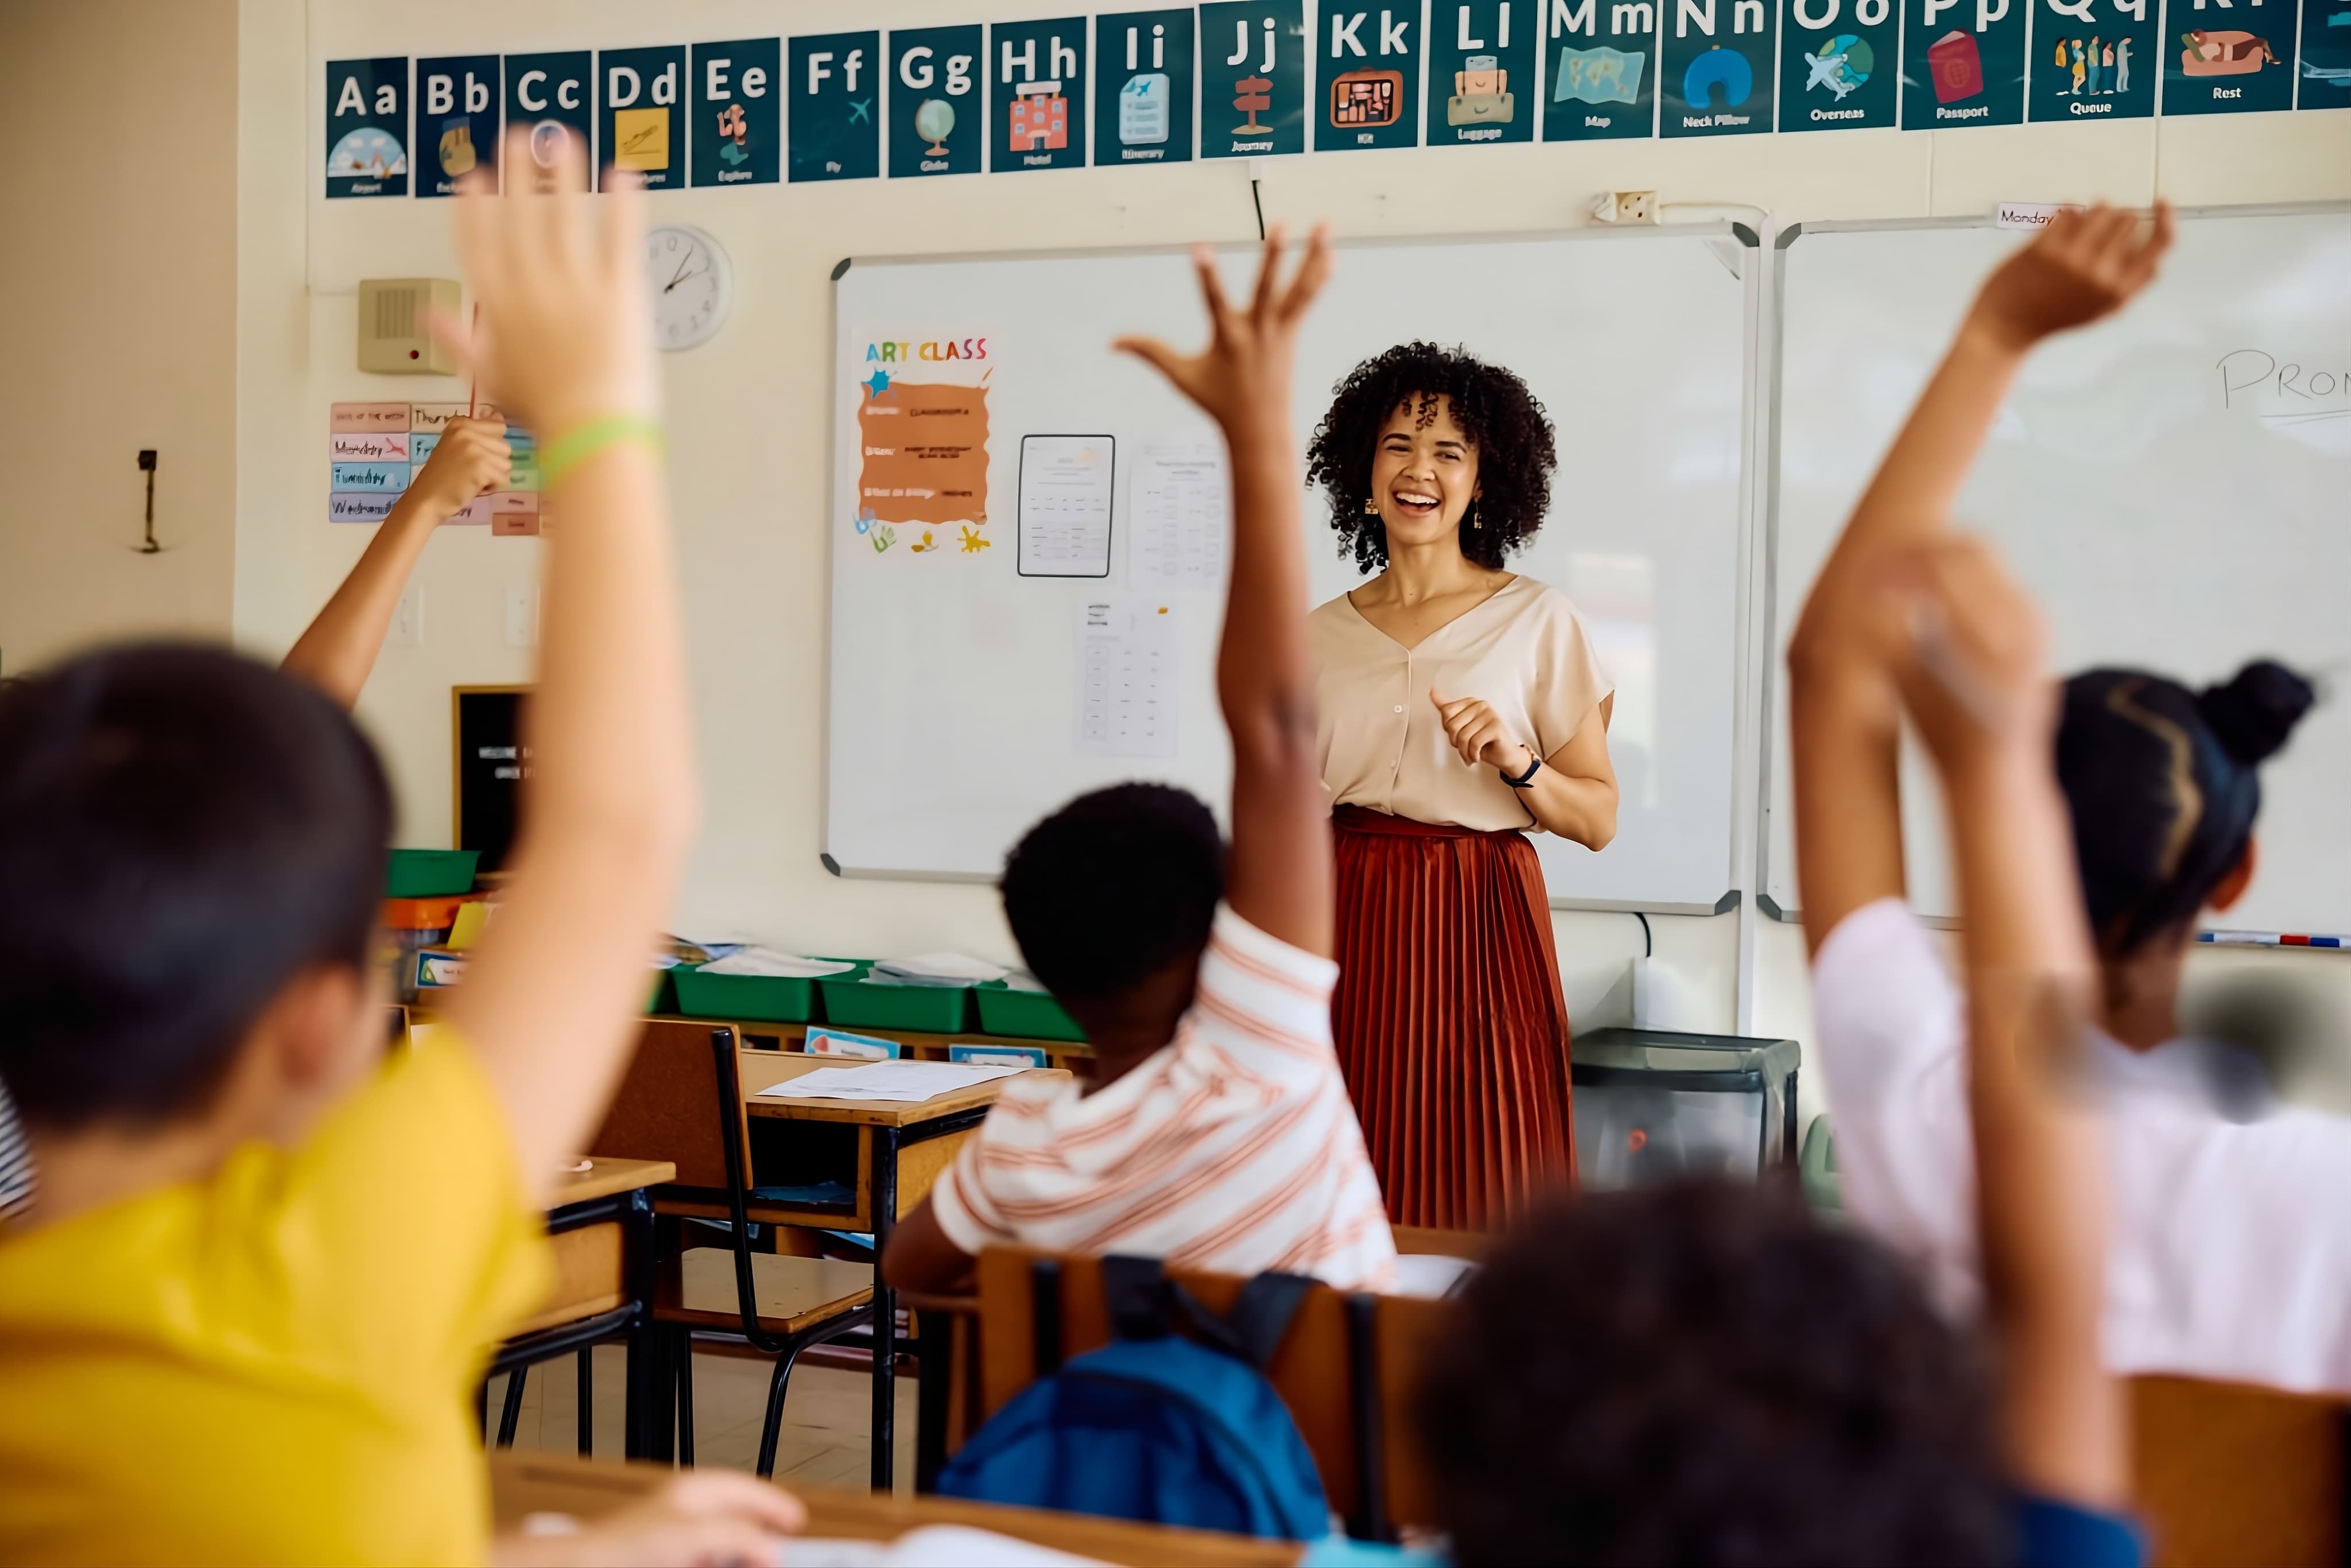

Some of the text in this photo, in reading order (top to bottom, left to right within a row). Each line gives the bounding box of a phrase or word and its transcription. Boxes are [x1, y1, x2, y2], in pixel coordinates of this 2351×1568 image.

[2213, 88, 2242, 99] Rest
[1810, 109, 1865, 121] Overseas
[1937, 106, 1989, 119] Passport
[2001, 209, 2054, 227] Monday
[866, 338, 987, 362] ART CLASS
[2216, 350, 2351, 409] PRO
